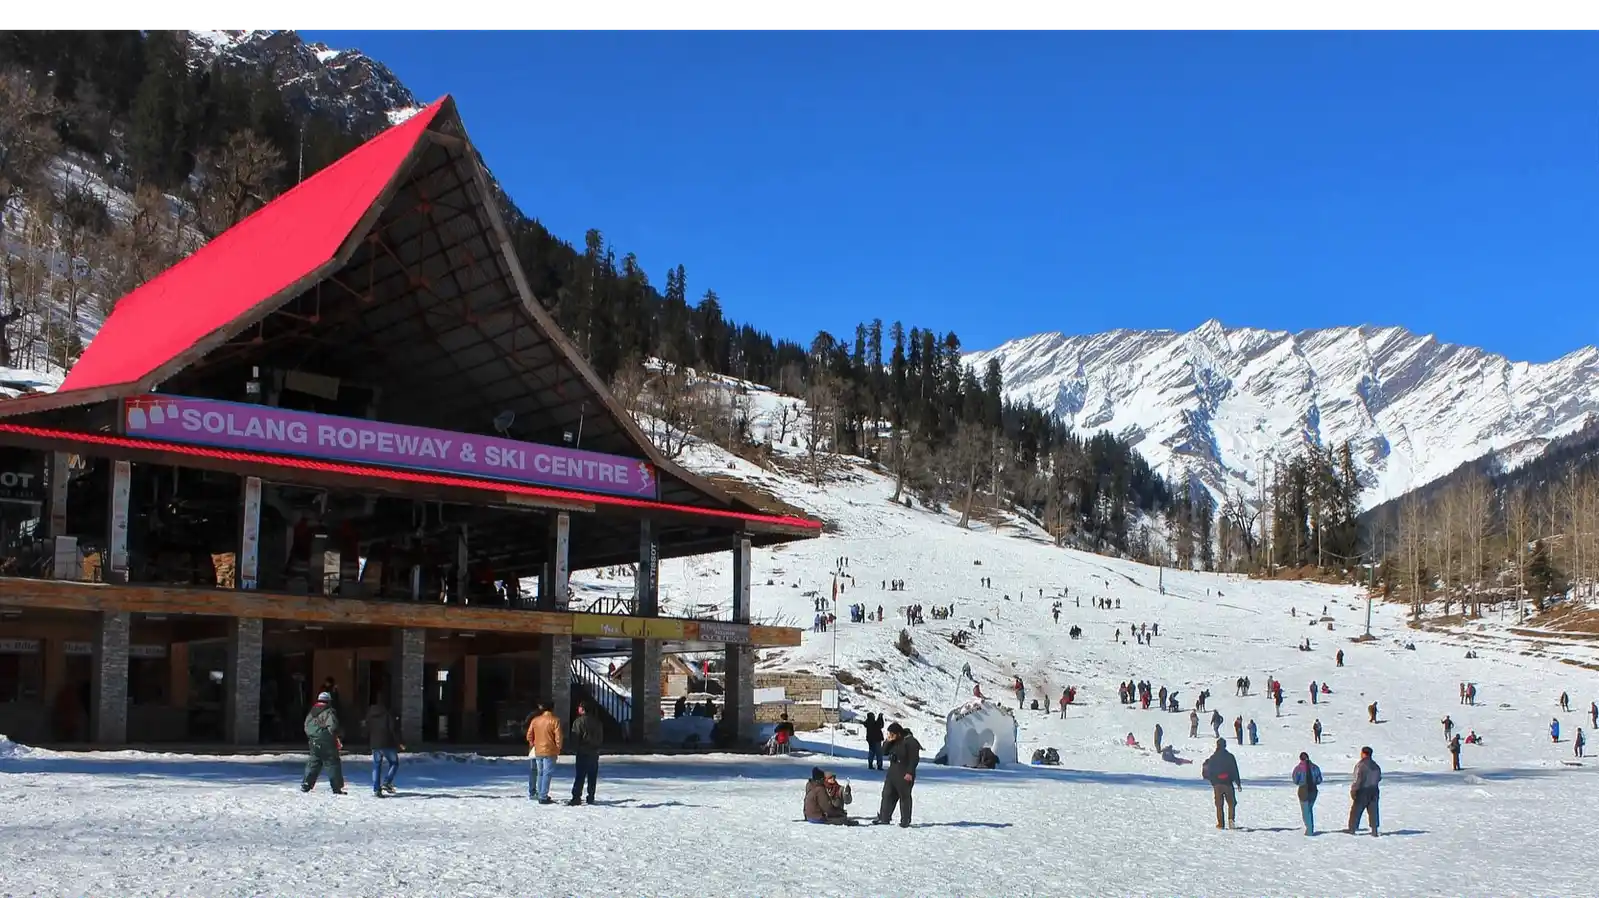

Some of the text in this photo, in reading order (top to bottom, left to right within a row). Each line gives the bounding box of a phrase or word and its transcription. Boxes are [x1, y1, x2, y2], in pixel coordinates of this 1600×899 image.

[181, 407, 630, 485] SOLANG ROPEWAY & SKI CENTRE
